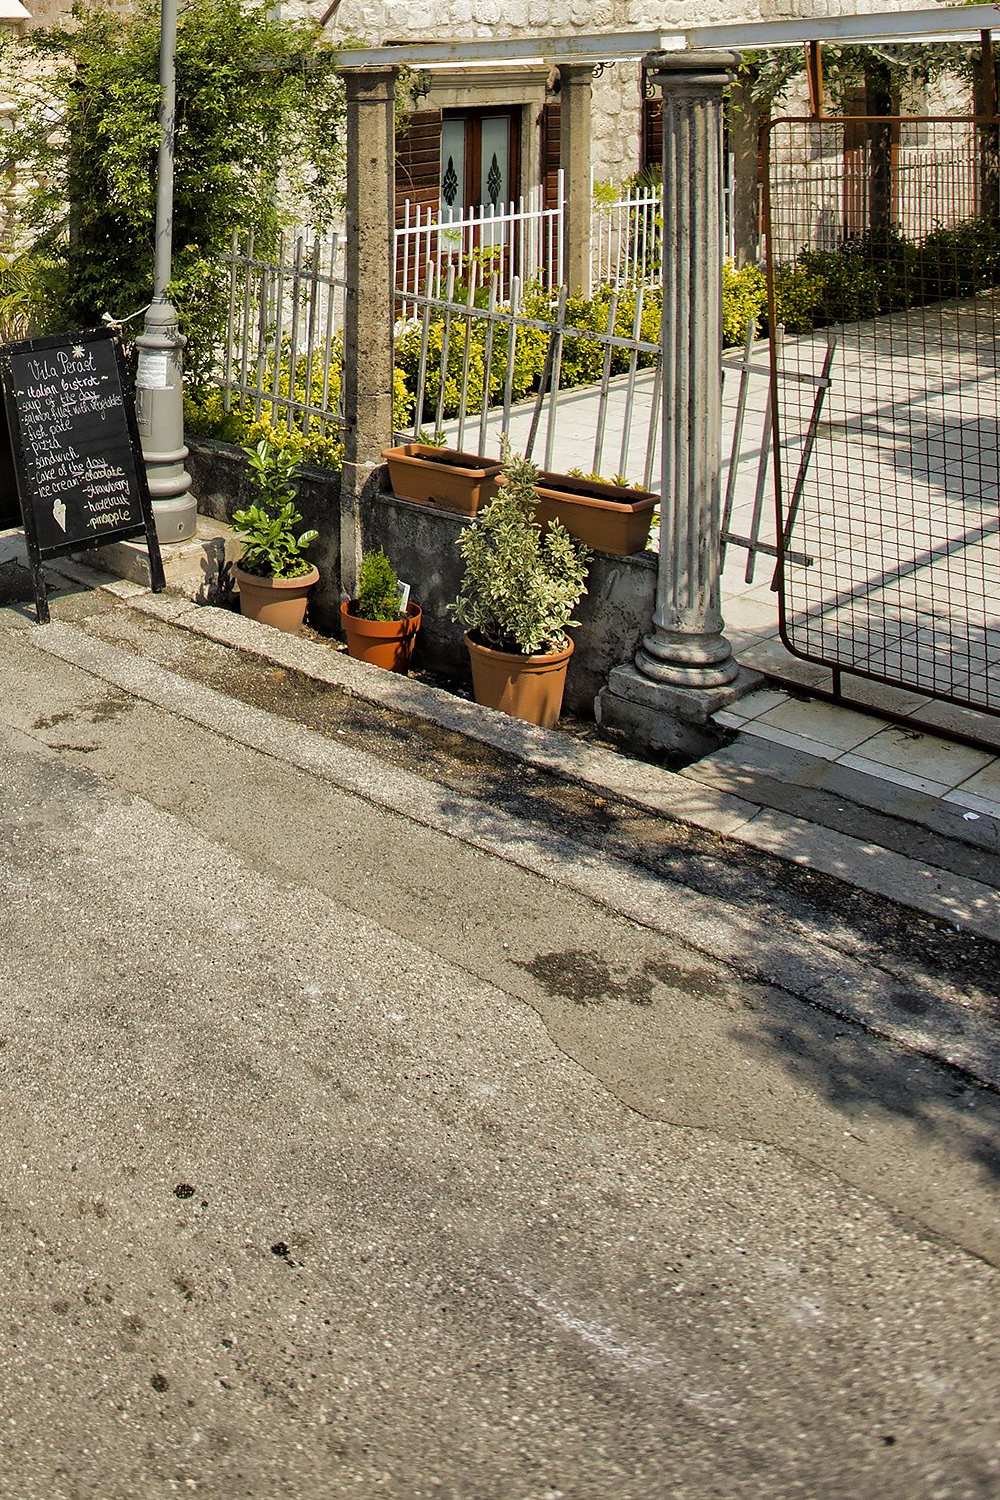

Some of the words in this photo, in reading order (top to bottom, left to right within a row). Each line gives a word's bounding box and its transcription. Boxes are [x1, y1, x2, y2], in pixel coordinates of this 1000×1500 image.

[56, 351, 97, 375] Perast
[27, 383, 59, 398] italian
[61, 375, 100, 391] bistrot
[45, 395, 56, 408] of
[60, 392, 76, 404] the
[78, 387, 98, 403] day
[50, 405, 73, 421] fillet
[72, 401, 91, 415] with
[58, 463, 67, 476] of
[68, 462, 85, 475] the
[86, 457, 107, 469] day
